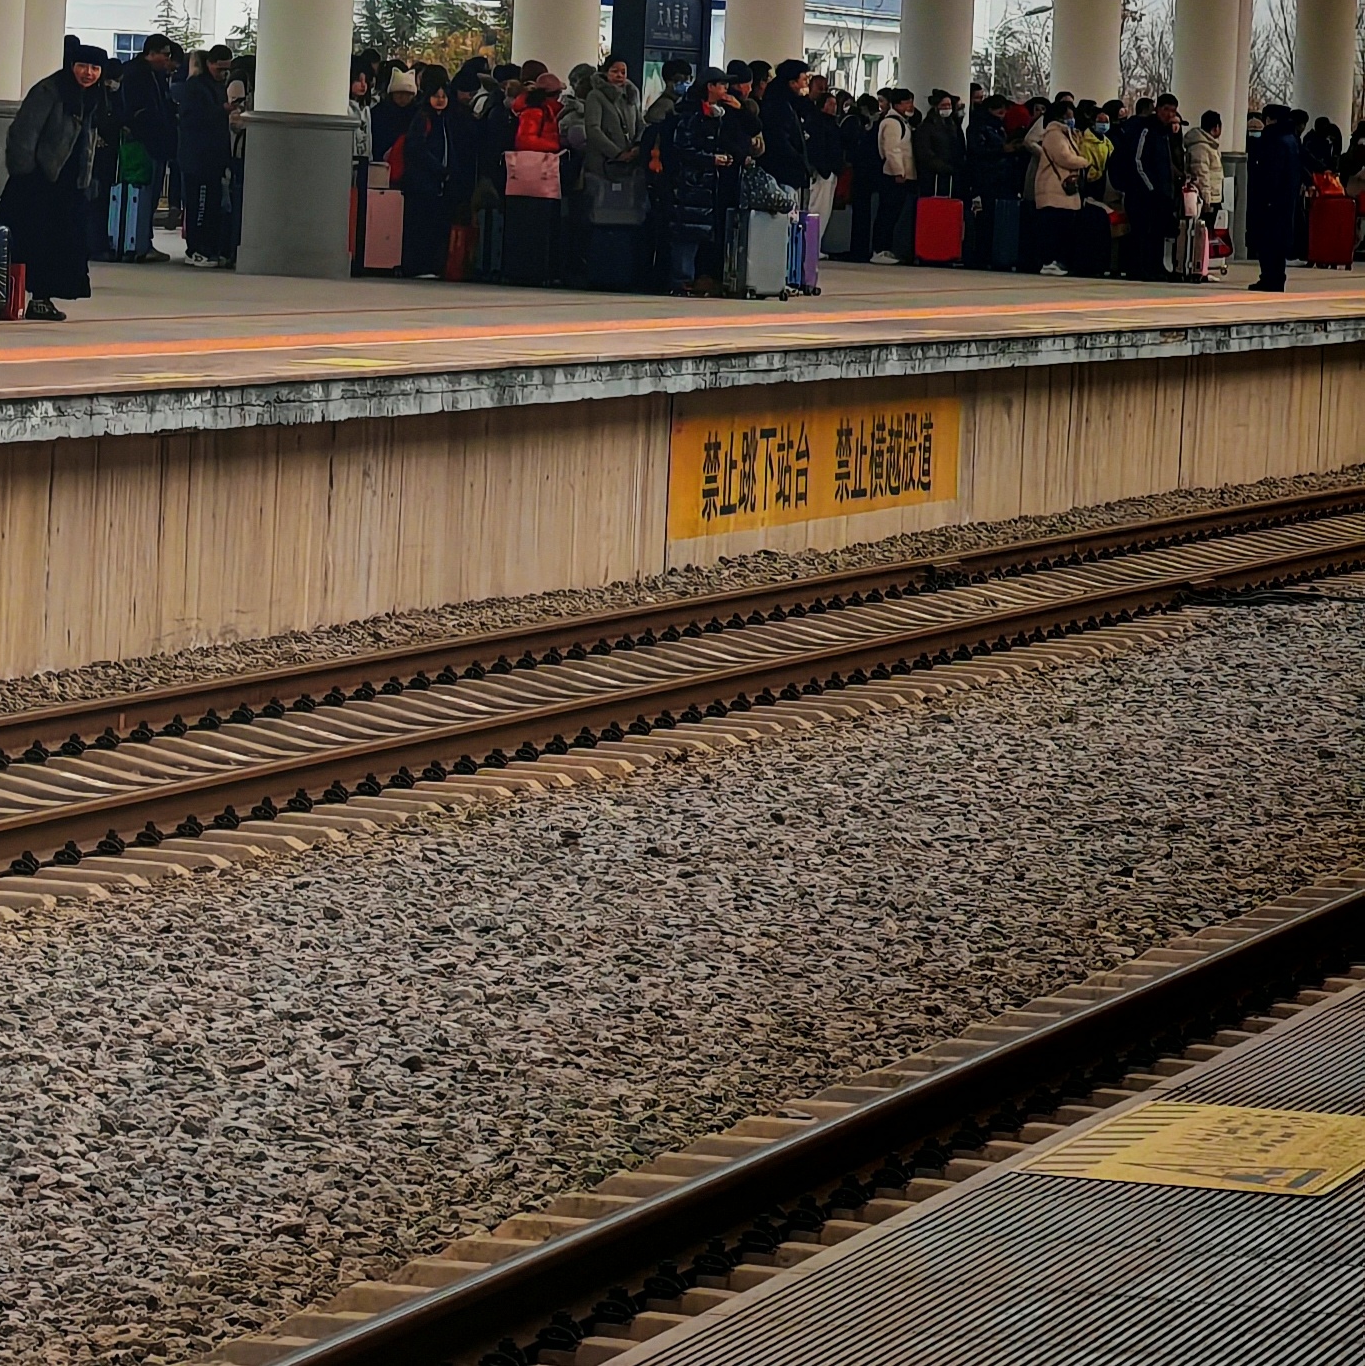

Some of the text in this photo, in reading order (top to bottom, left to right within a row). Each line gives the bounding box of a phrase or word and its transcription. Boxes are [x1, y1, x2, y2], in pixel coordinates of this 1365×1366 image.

[701, 411, 934, 522] 禁止跳下站台 禁止横越股道
